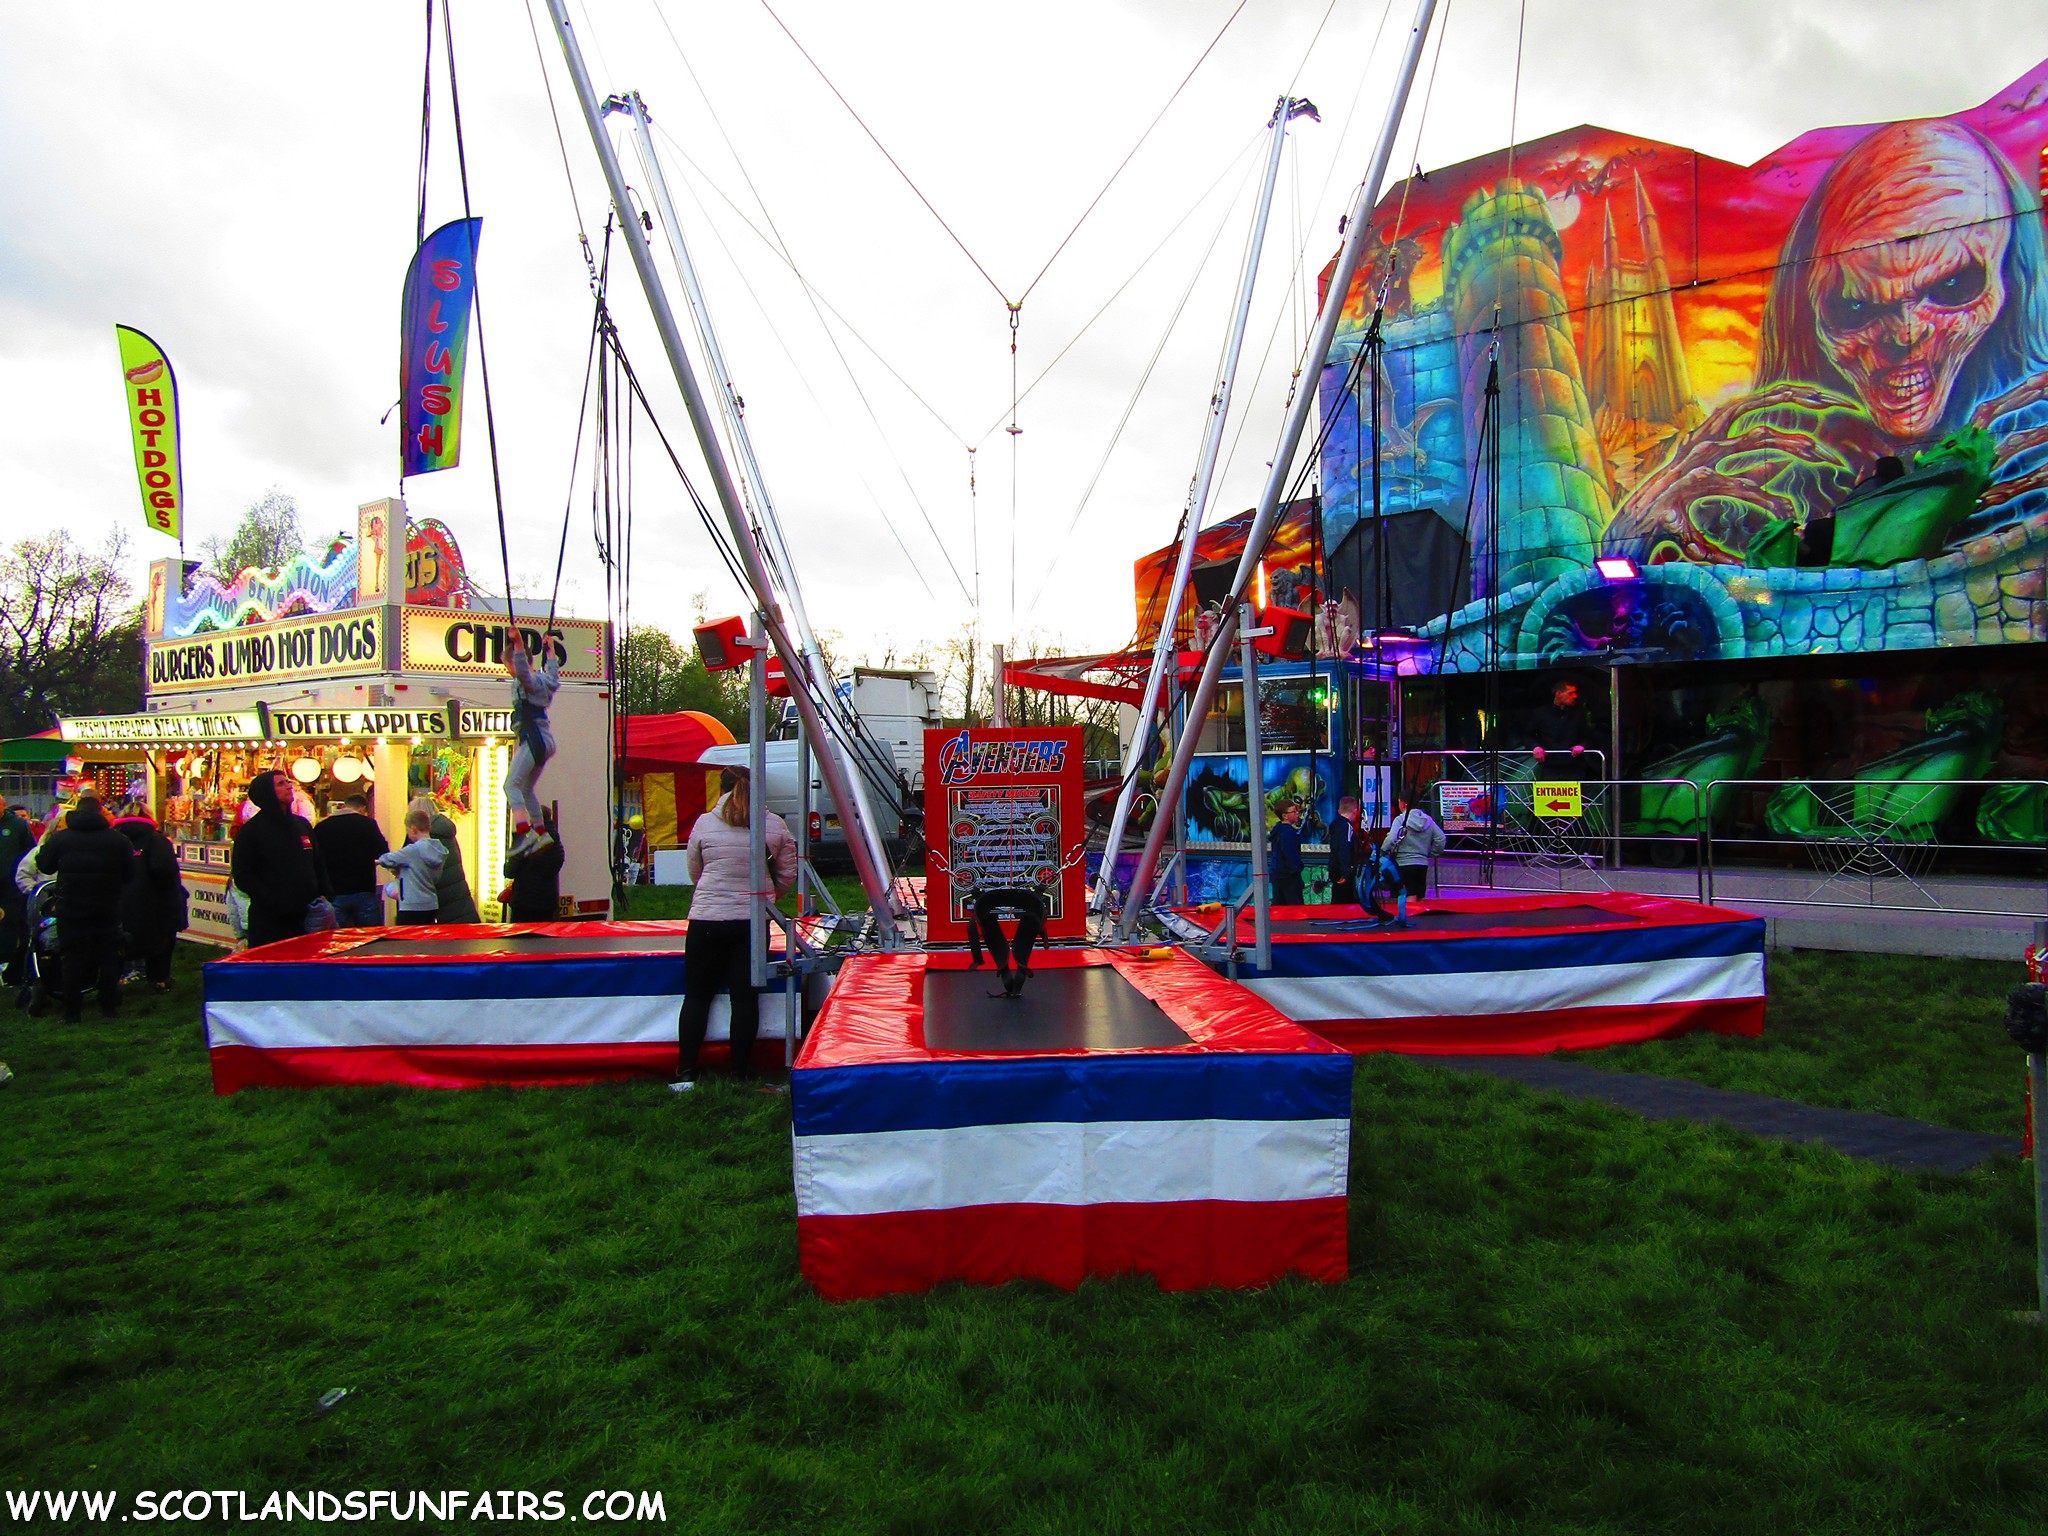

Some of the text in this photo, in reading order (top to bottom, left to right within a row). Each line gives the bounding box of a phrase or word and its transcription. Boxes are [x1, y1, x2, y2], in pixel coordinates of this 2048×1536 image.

[418, 259, 463, 457] SLUSH
[152, 617, 377, 684] BURGERS JUMBO HOT DOGS
[444, 621, 568, 672] CHPS
[75, 714, 243, 739] FRESHLY PREPARED STEAK & CHICKEN
[273, 712, 447, 735] TOFFEE APPLES
[939, 730, 1067, 785] AVENGERS
[1362, 802, 1389, 817] HEE
[1536, 787, 1579, 797] ENTRANCE
